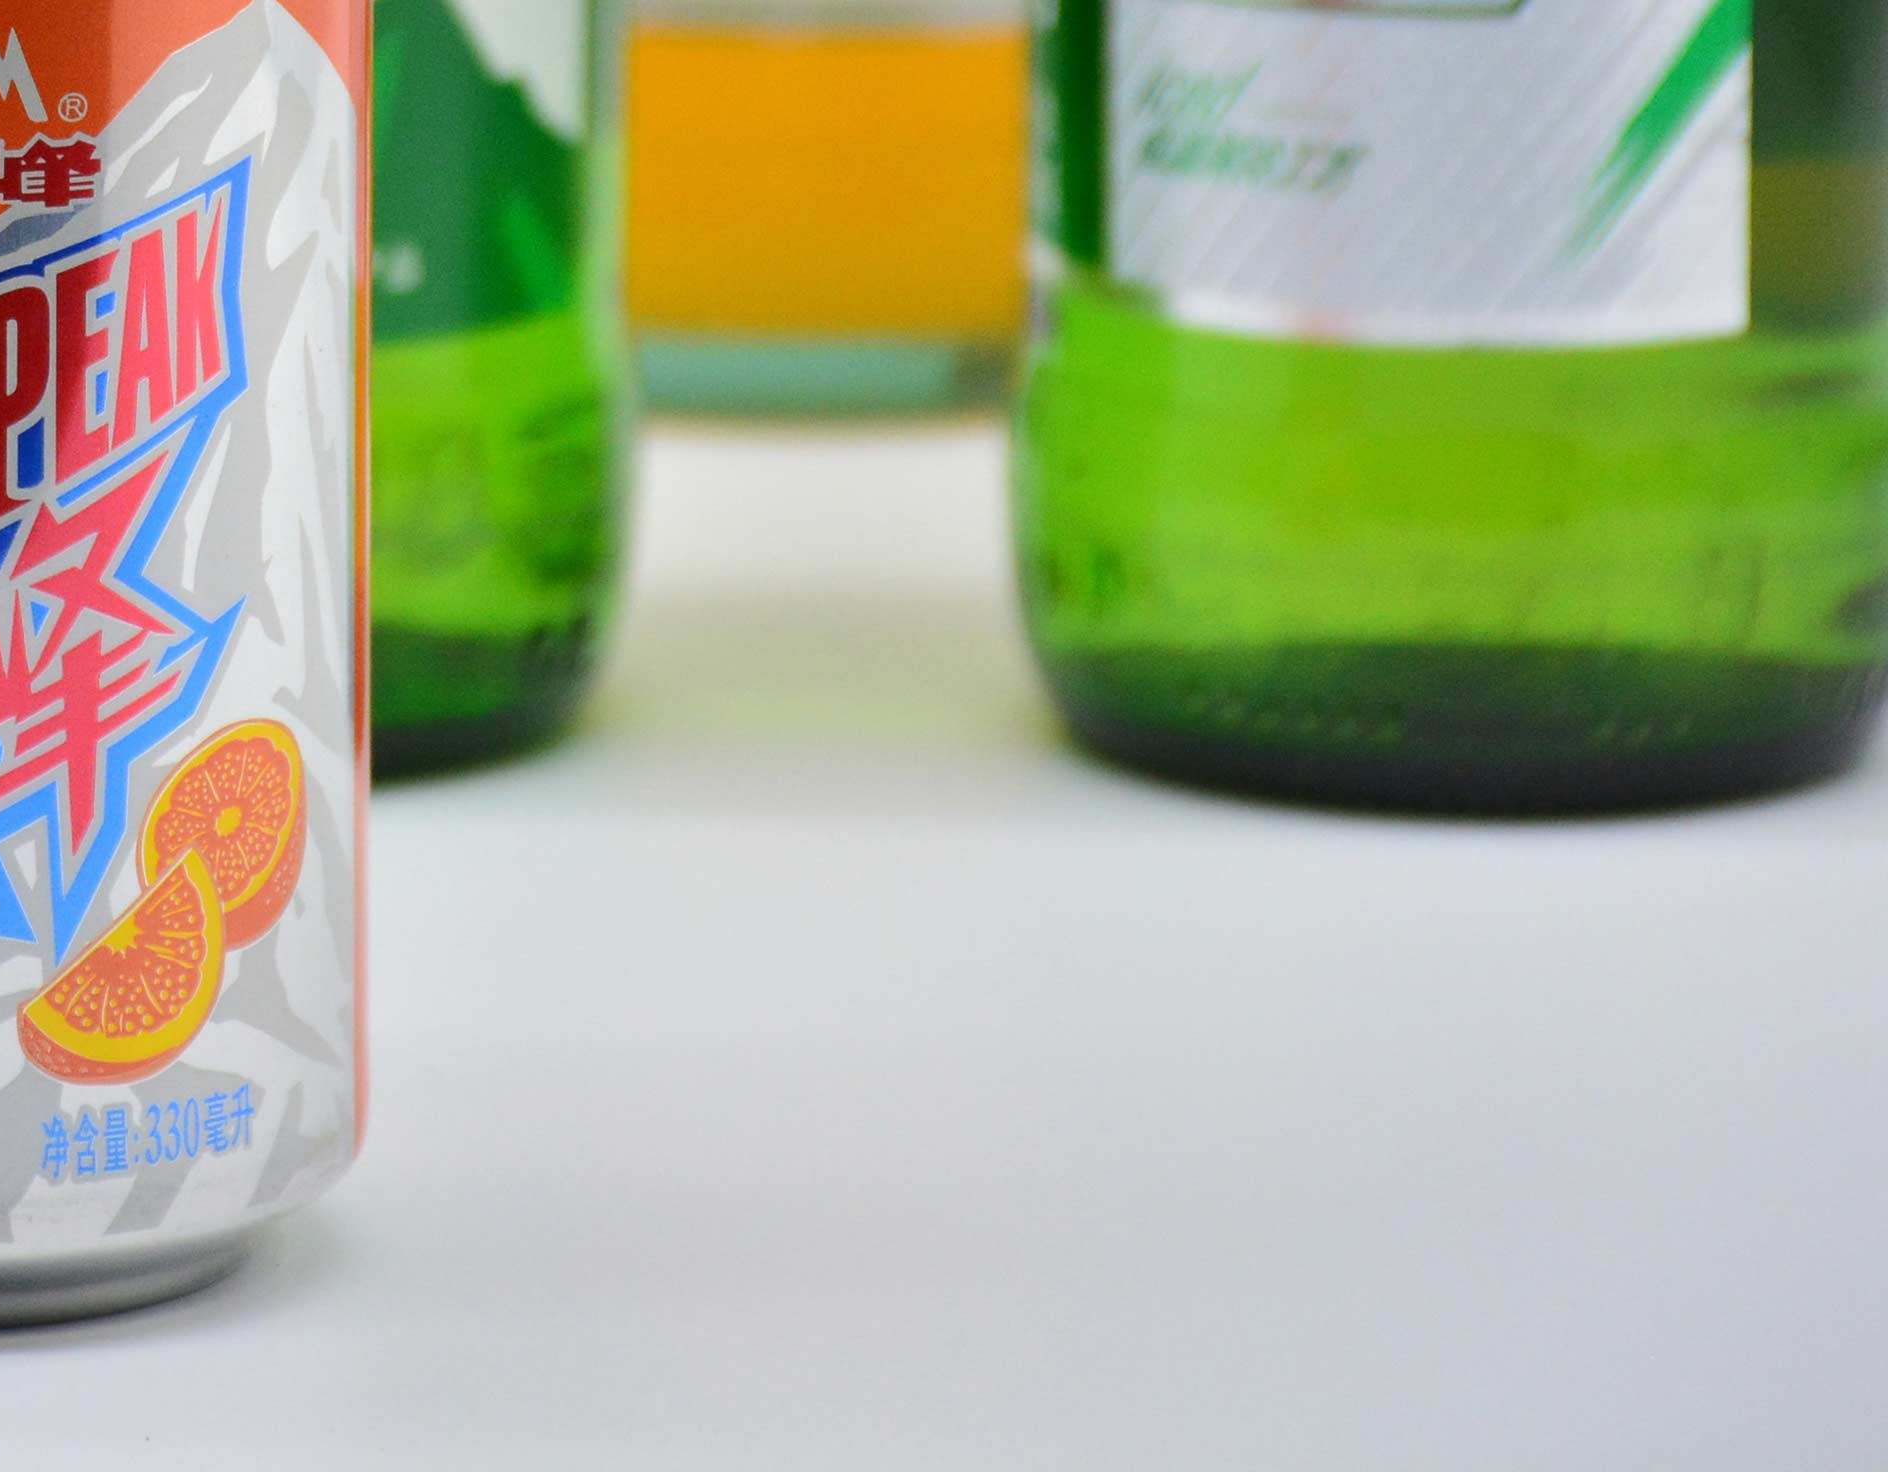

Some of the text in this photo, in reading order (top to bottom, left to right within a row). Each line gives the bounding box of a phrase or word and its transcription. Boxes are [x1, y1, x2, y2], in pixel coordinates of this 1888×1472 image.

[41, 1081, 256, 1182] 净含量:330毫升
